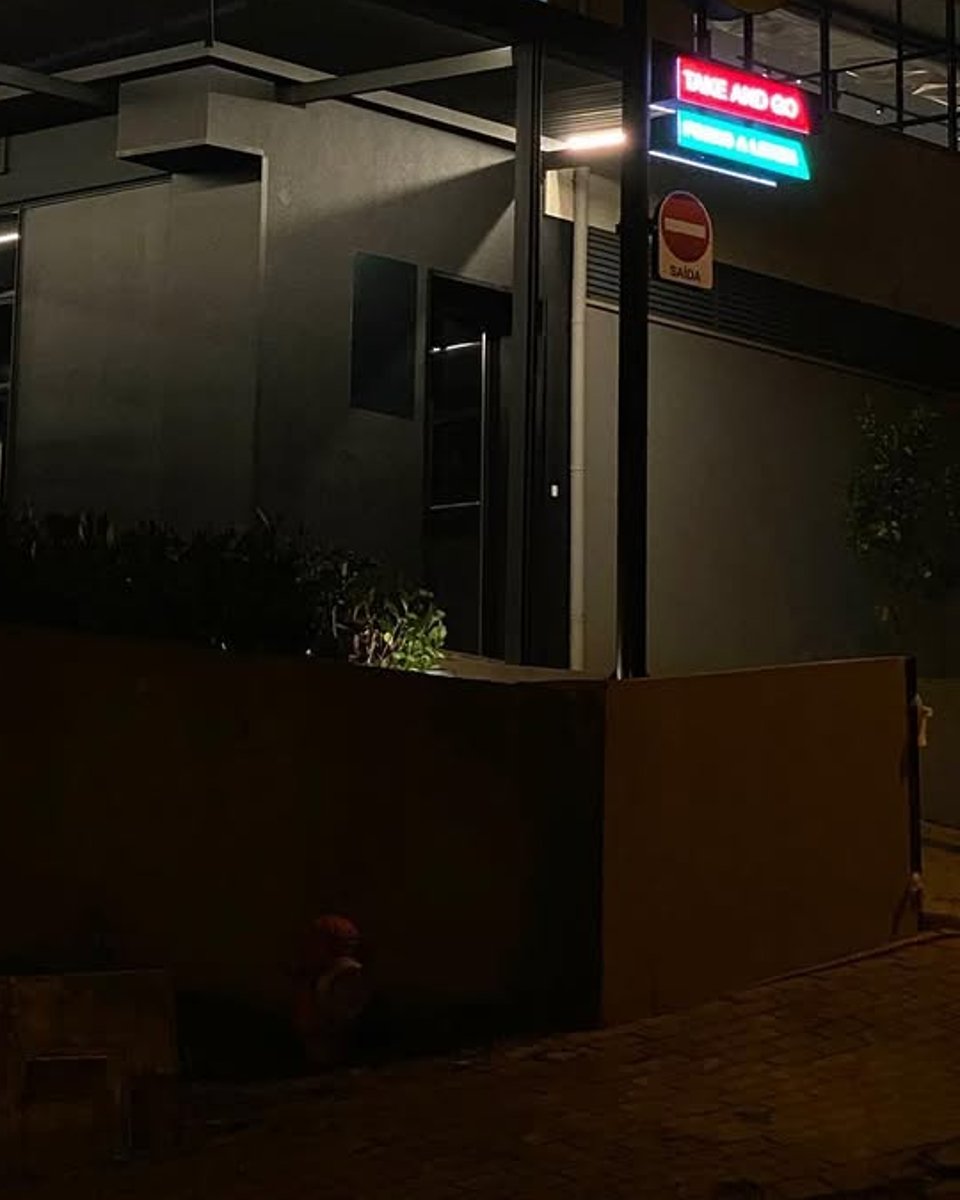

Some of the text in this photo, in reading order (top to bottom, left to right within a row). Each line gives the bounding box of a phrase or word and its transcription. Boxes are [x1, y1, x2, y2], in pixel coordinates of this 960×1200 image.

[682, 69, 800, 120] TAKE AND GO
